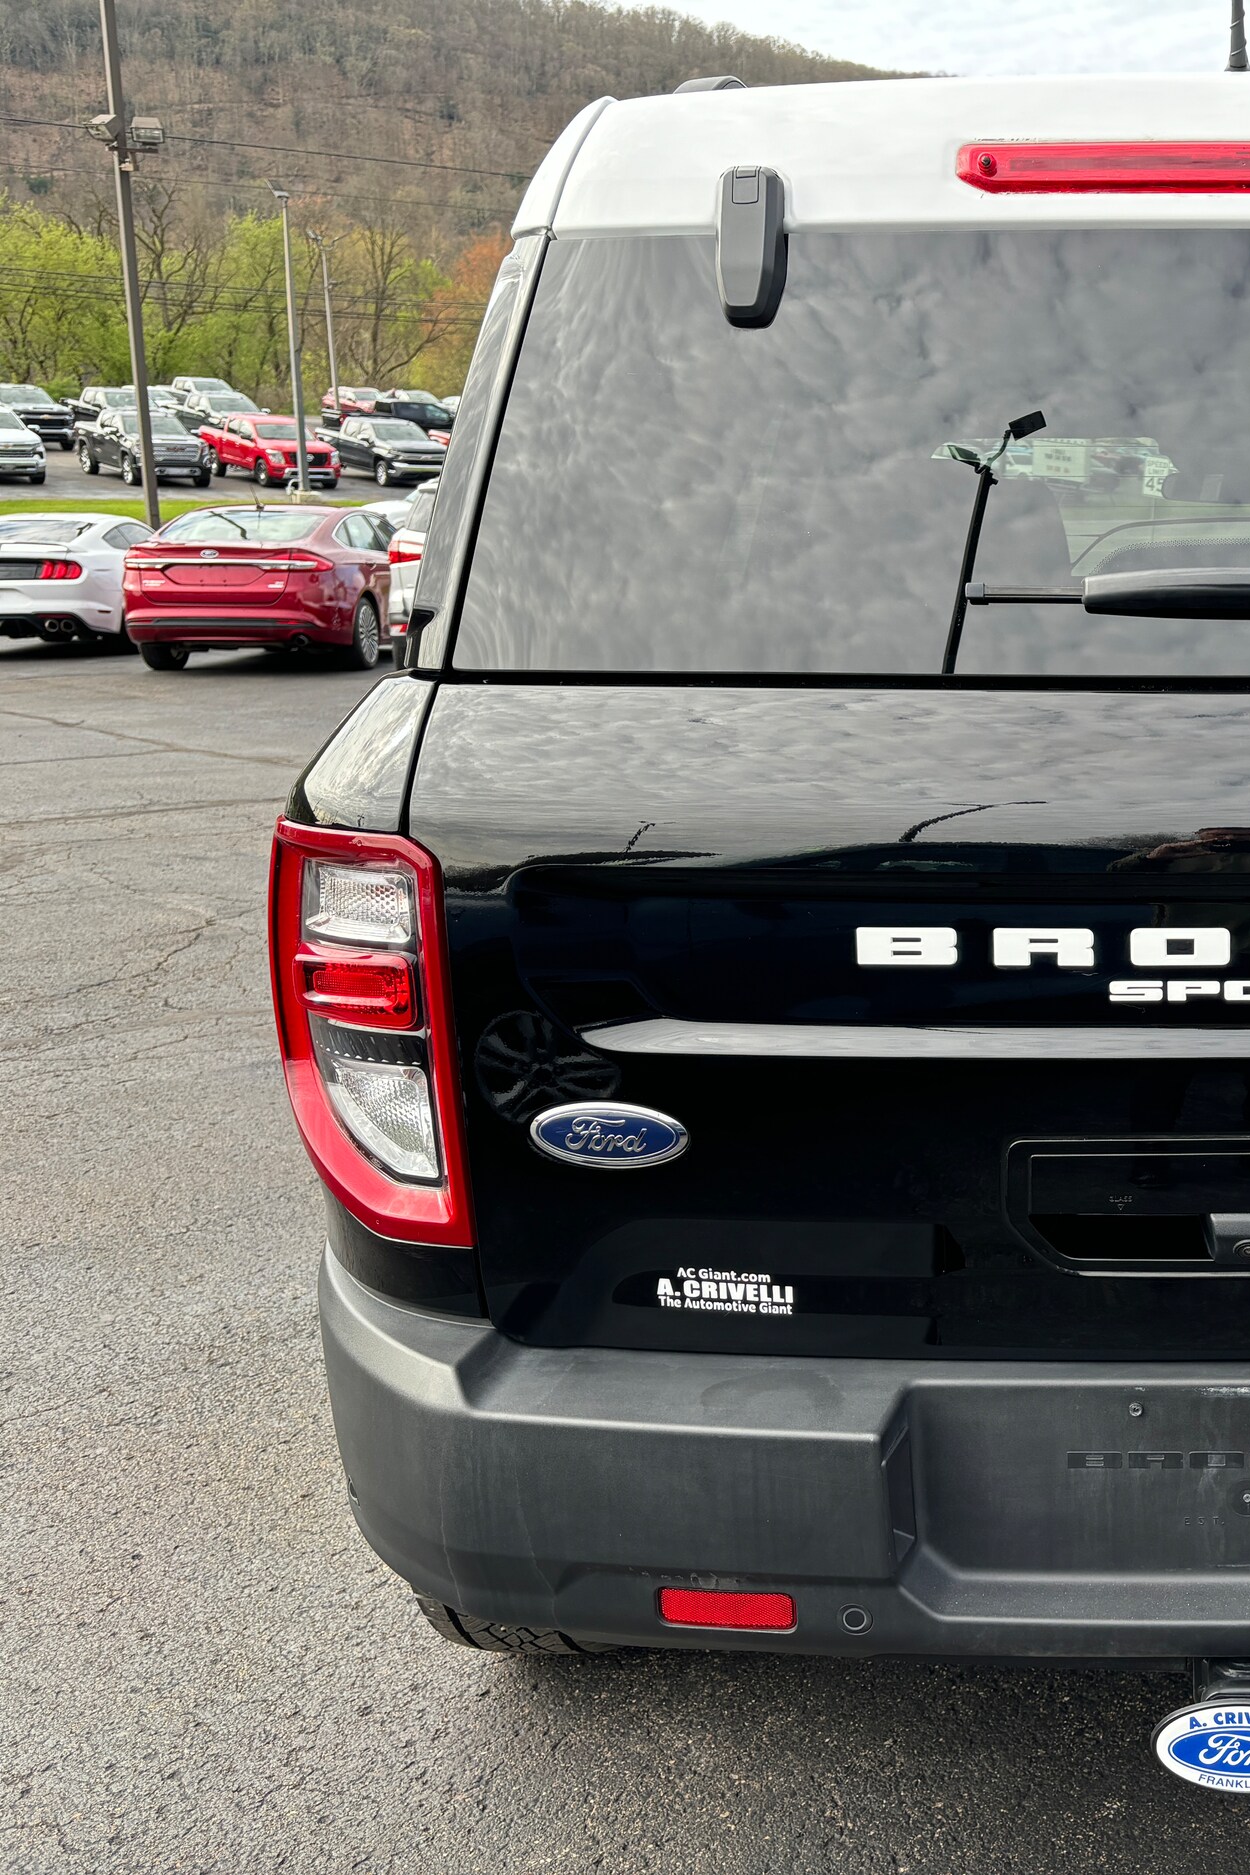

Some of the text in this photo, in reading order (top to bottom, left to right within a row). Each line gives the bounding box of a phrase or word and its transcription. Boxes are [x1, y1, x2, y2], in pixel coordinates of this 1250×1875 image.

[564, 1116, 648, 1153] Ford
[676, 1267, 771, 1283] AC Giant.com
[656, 1278, 794, 1304] A. CRIVELLI
[658, 1296, 793, 1315] The Automotive Giant
[1189, 1716, 1207, 1730] A.
